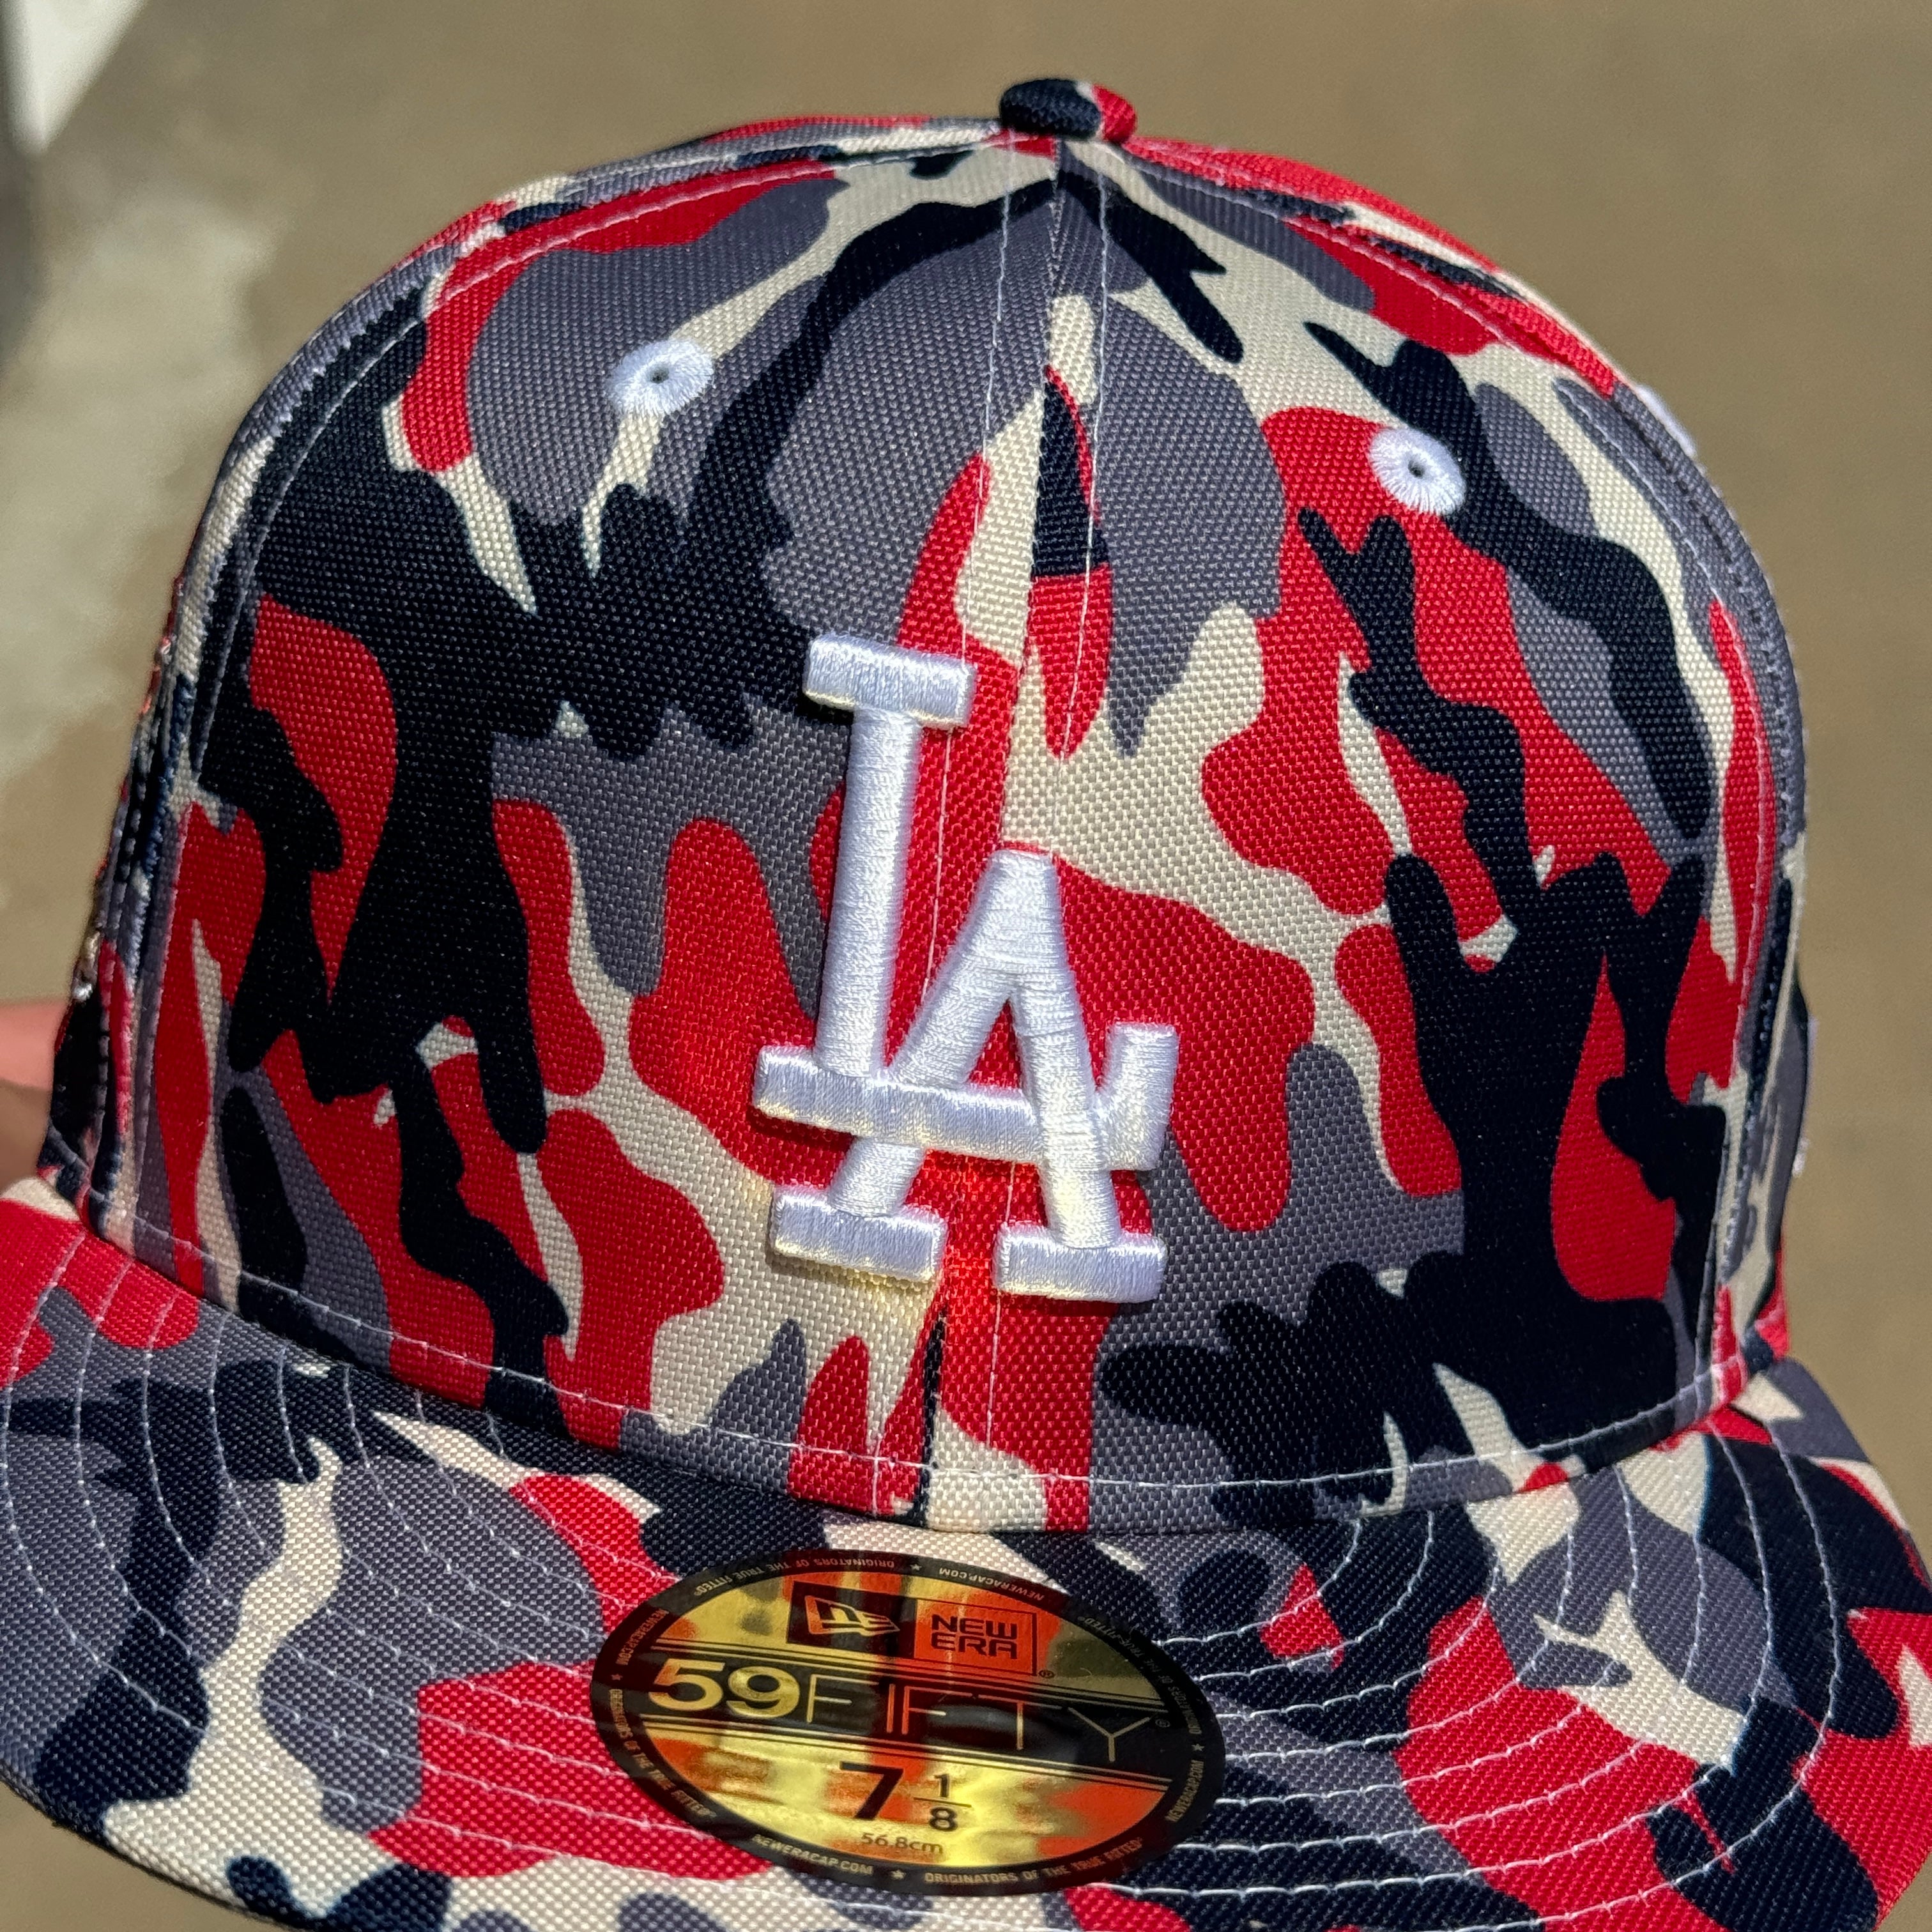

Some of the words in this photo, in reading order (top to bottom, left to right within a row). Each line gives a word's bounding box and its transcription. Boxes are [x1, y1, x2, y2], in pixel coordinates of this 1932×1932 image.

[753, 634, 1179, 1303] LA
[736, 1567, 765, 1581] TRUE
[767, 1561, 792, 1573] THE
[939, 1567, 1046, 1602] NEWERACAP.COM
[931, 1614, 1018, 1640] NEW
[931, 1632, 1018, 1660] ERA
[648, 1658, 1151, 1762] 59FIFTY
[839, 1761, 904, 1820] 7
[861, 1832, 944, 1854] 56.8cm
[924, 1871, 1018, 1884] ORIGINATORS
